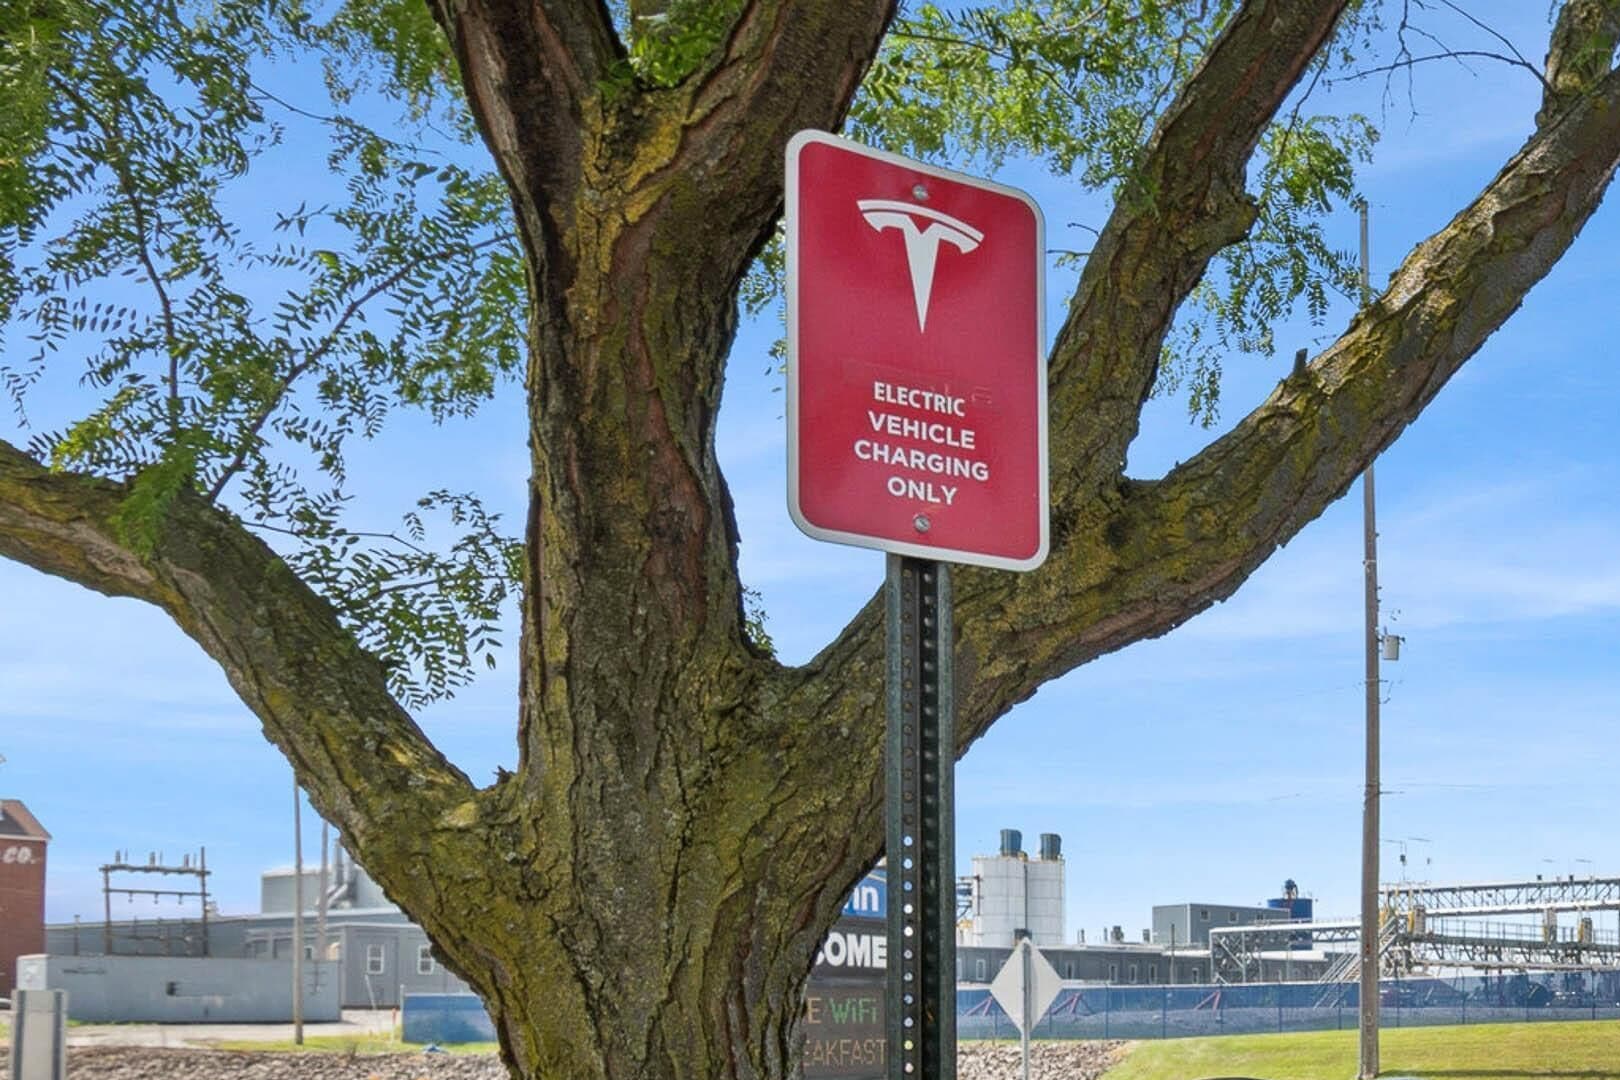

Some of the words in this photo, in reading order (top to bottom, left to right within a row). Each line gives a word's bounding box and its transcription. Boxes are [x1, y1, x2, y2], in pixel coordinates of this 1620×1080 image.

[874, 381, 966, 417] ELECTRIC
[867, 410, 976, 450] VEHICLE
[854, 439, 990, 481] CHARGING
[887, 476, 957, 505] ONLY
